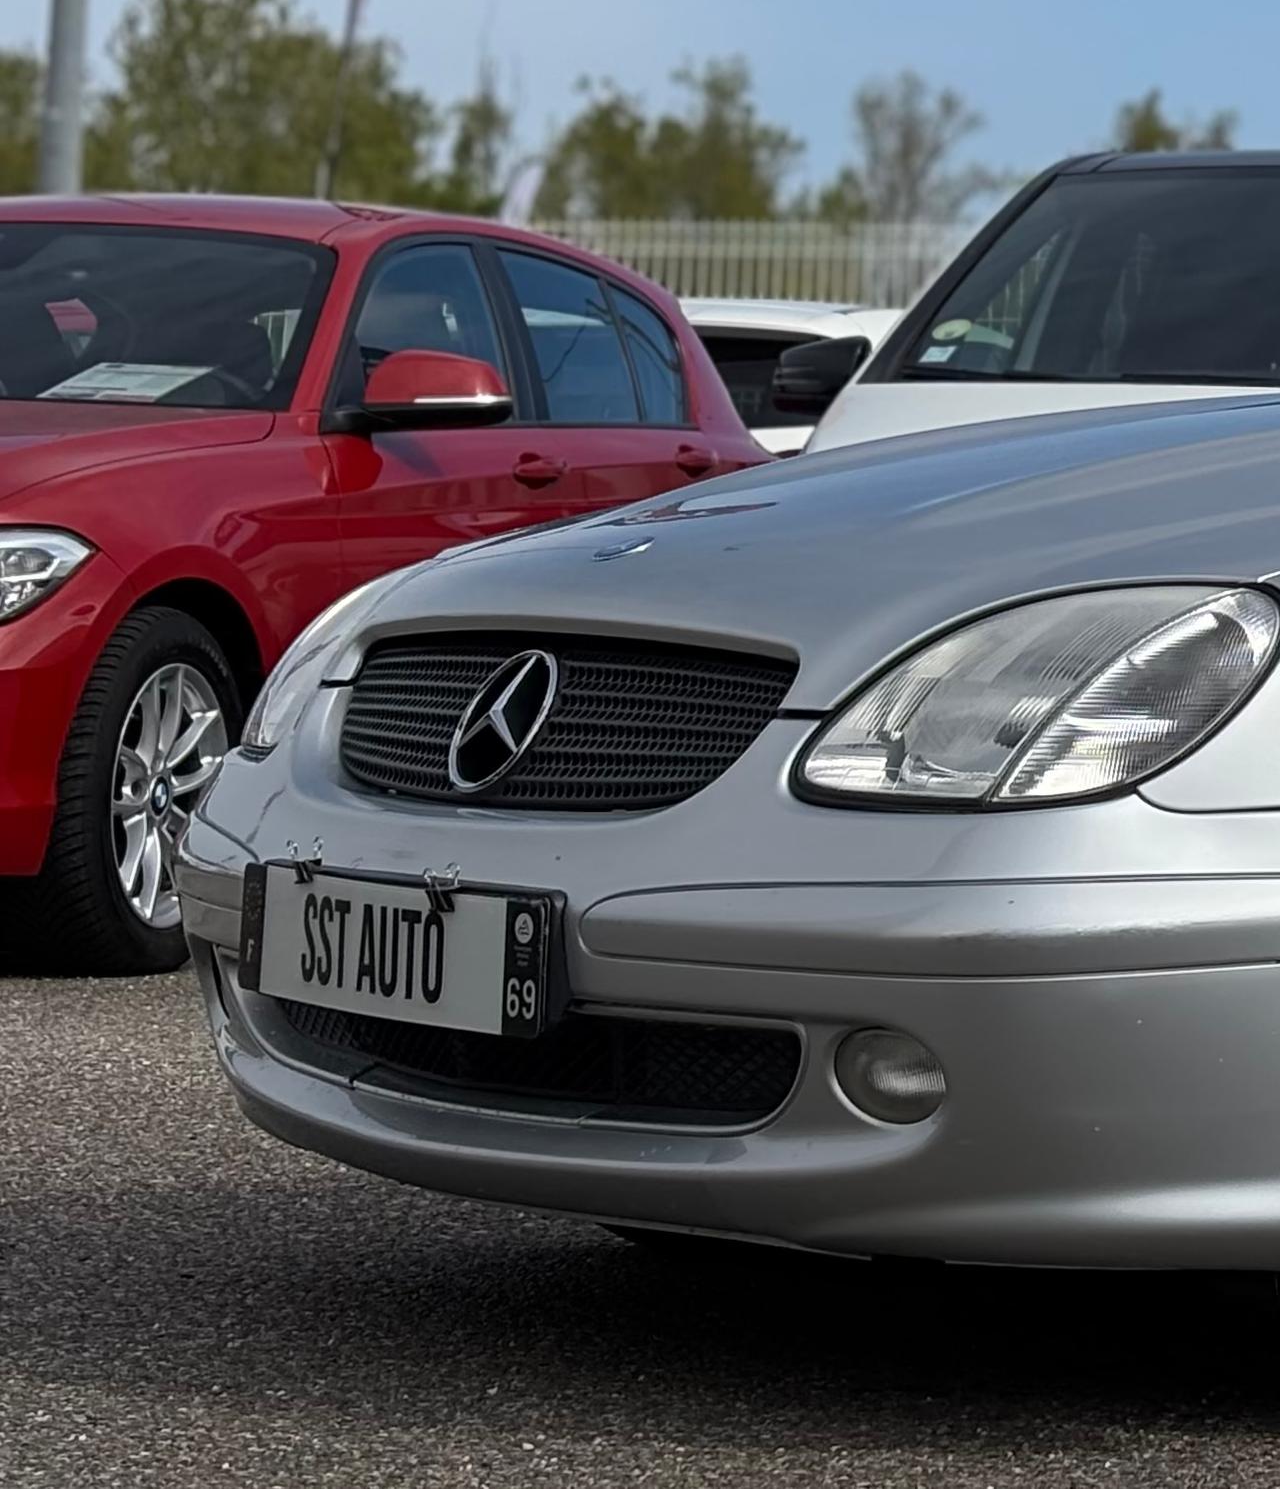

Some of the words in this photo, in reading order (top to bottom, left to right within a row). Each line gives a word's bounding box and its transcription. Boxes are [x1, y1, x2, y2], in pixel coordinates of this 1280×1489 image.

[300, 893, 351, 988] SST
[355, 903, 446, 1004] AUTO
[505, 976, 537, 1020] 69
